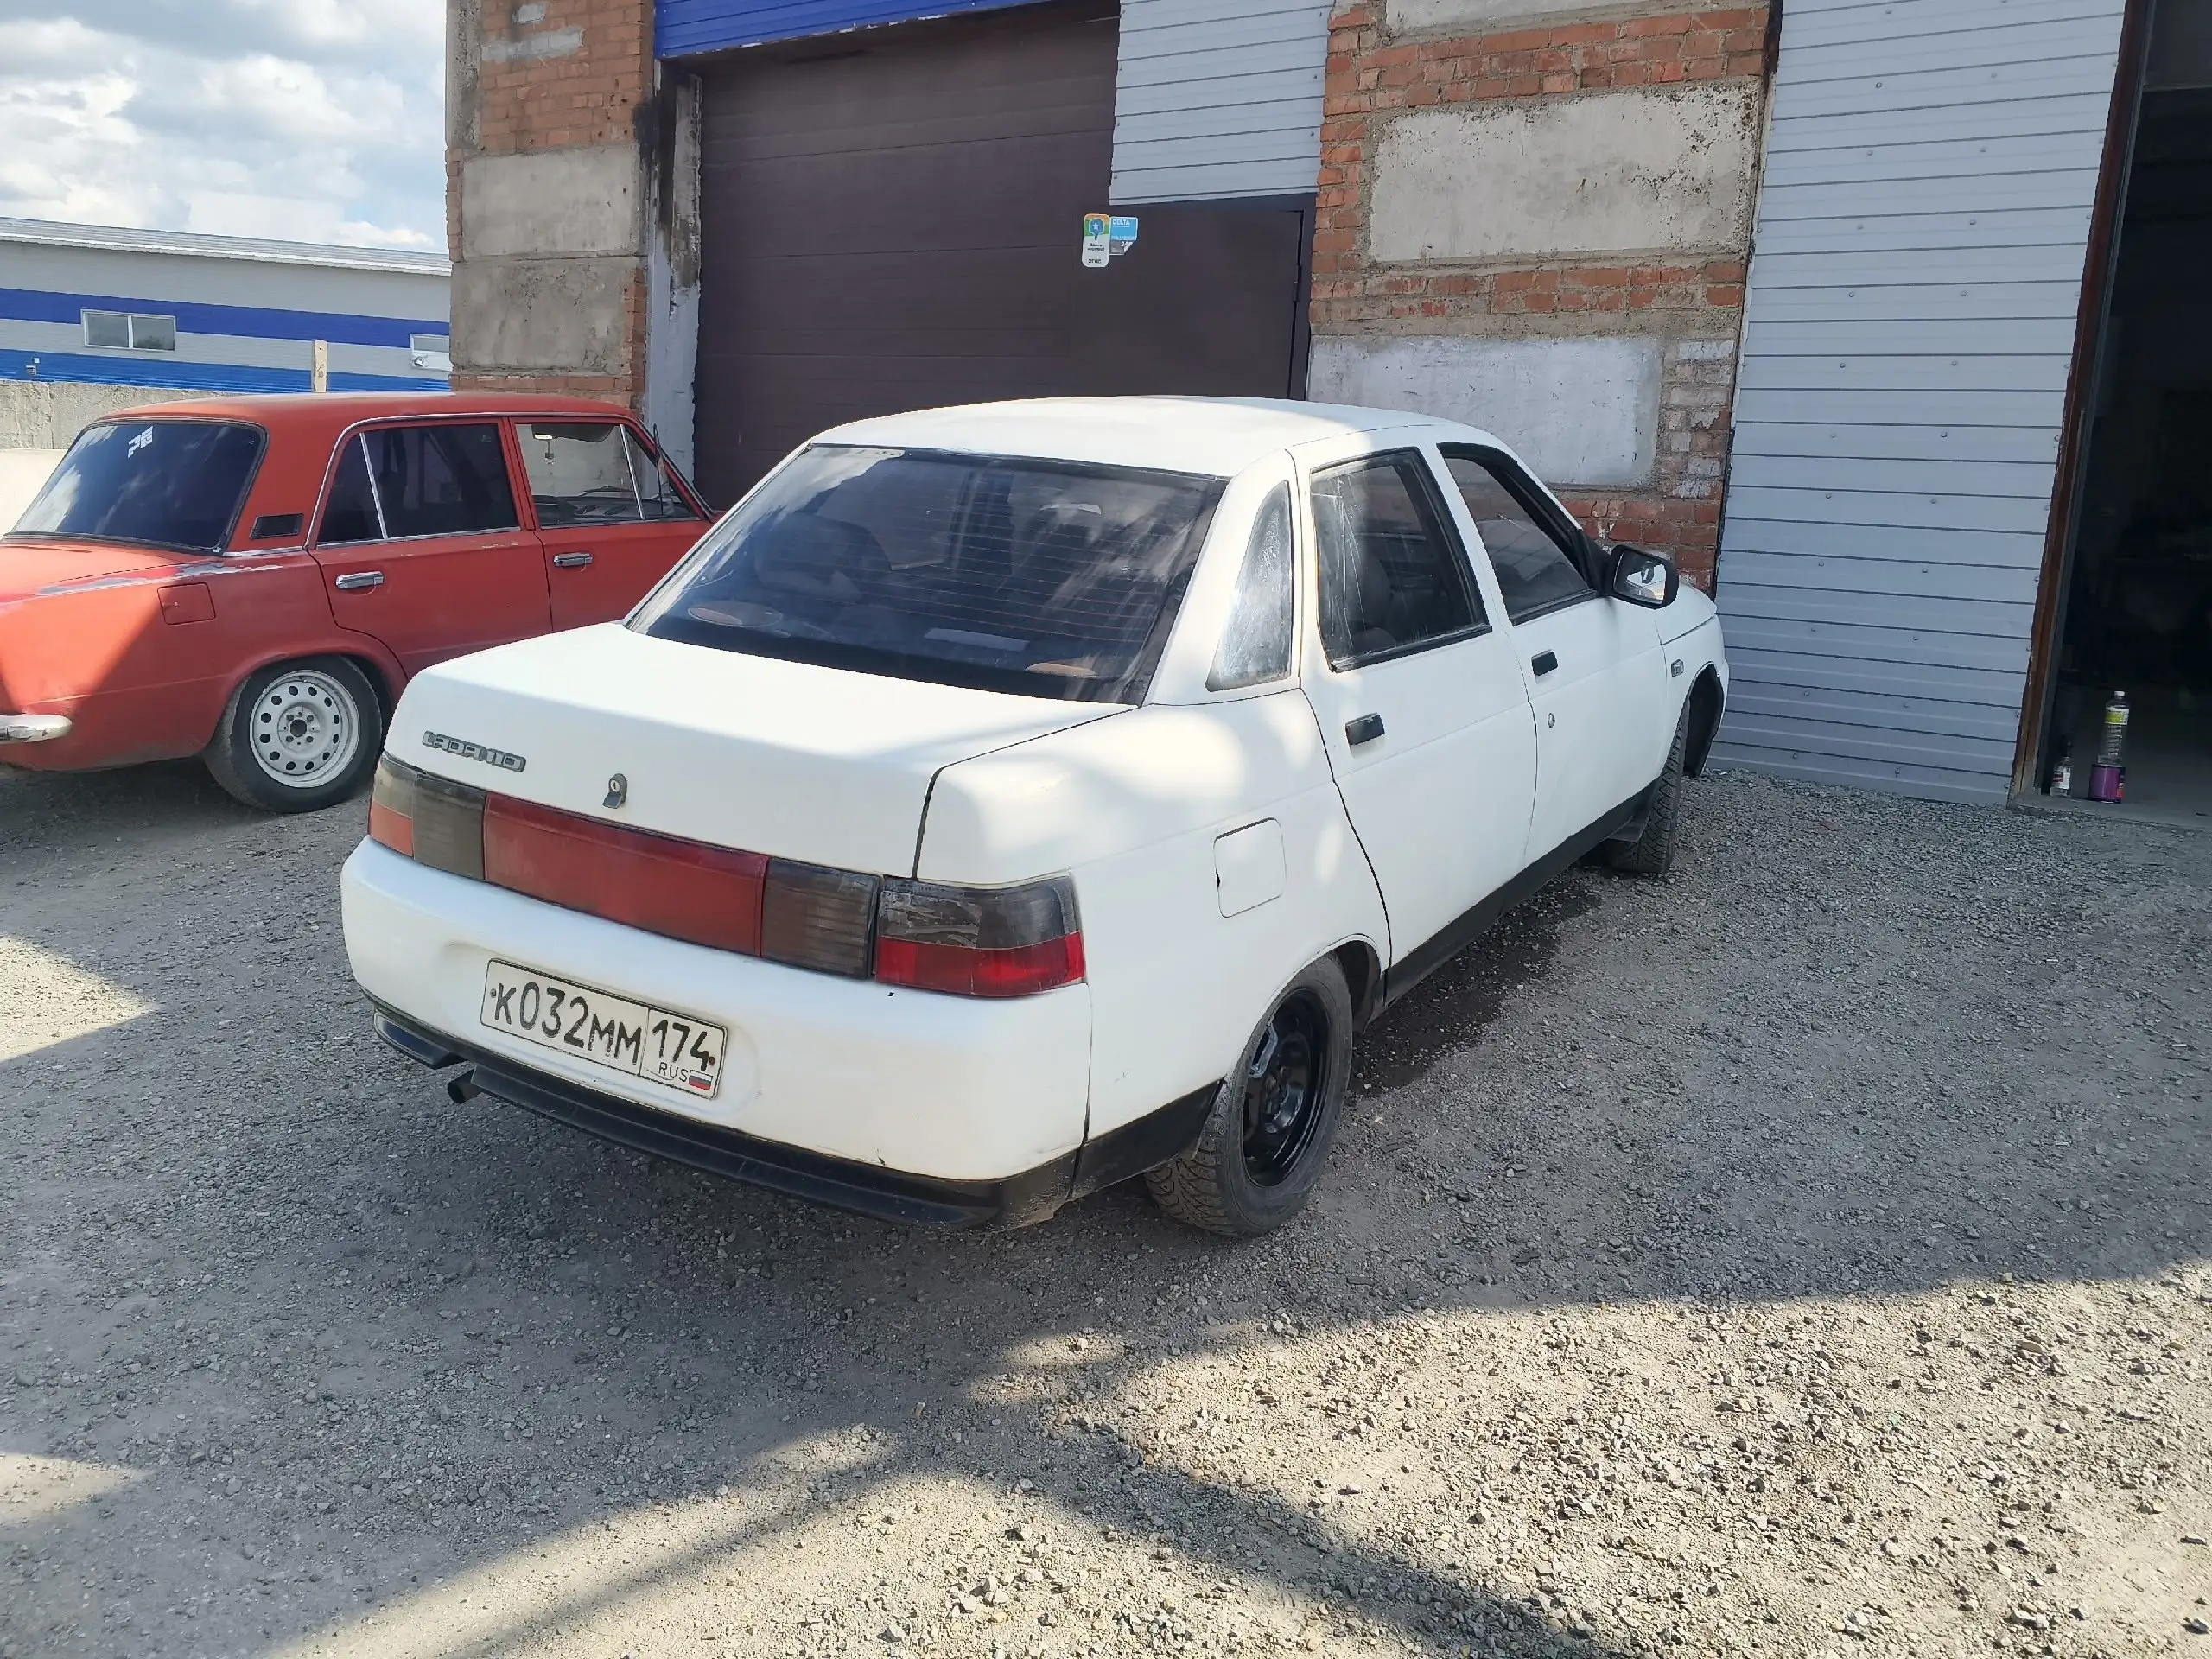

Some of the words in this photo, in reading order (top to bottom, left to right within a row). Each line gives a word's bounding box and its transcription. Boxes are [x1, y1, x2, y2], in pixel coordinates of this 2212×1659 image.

[422, 730, 486, 761] LADA
[486, 748, 526, 772] 110
[652, 1019, 709, 1072] 174
[658, 1061, 689, 1083] RUS
